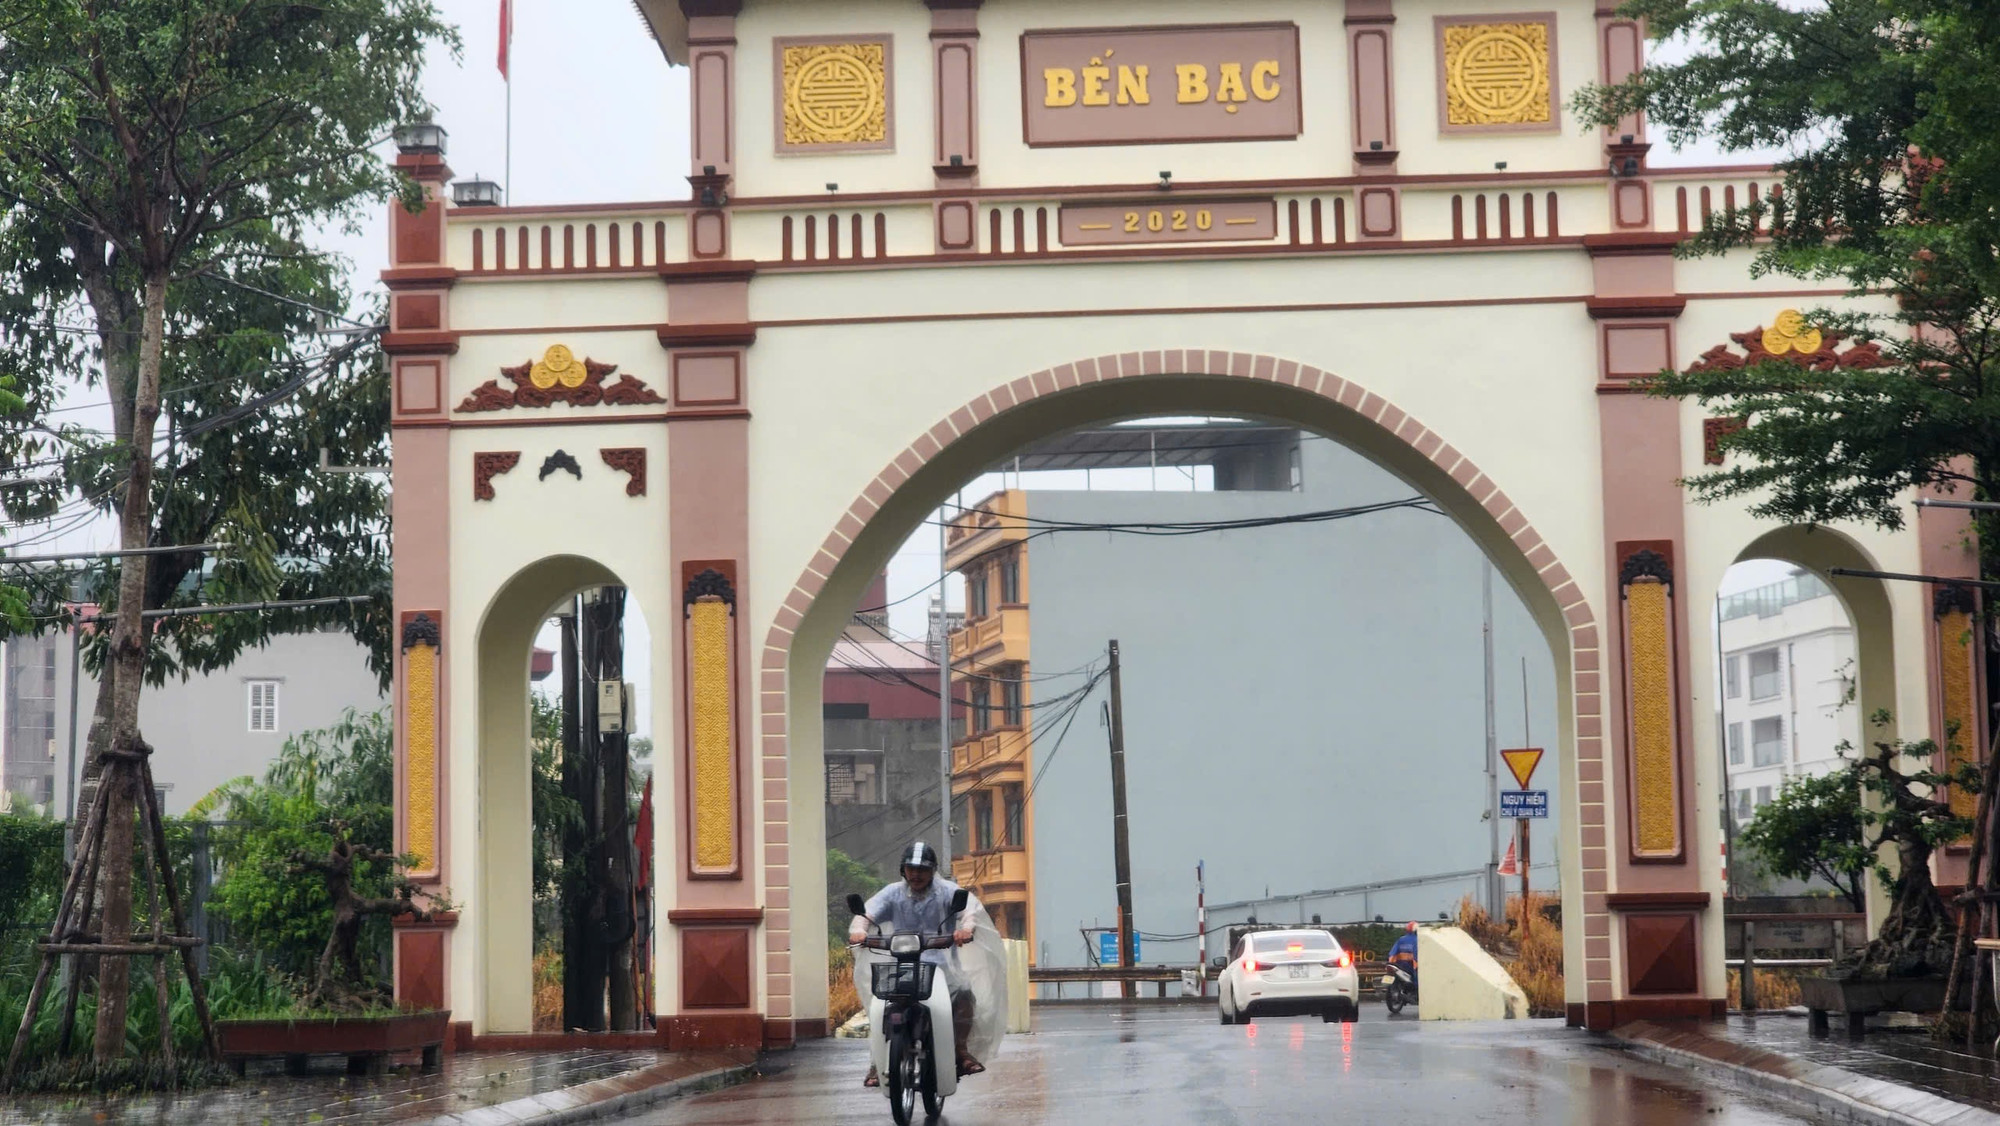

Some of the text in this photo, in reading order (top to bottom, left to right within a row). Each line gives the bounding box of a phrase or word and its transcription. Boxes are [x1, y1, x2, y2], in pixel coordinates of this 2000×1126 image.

[1044, 49, 1281, 113] BẾN BẠC
[1124, 210, 1212, 232] 2020
[1502, 795, 1525, 805] NGUY
